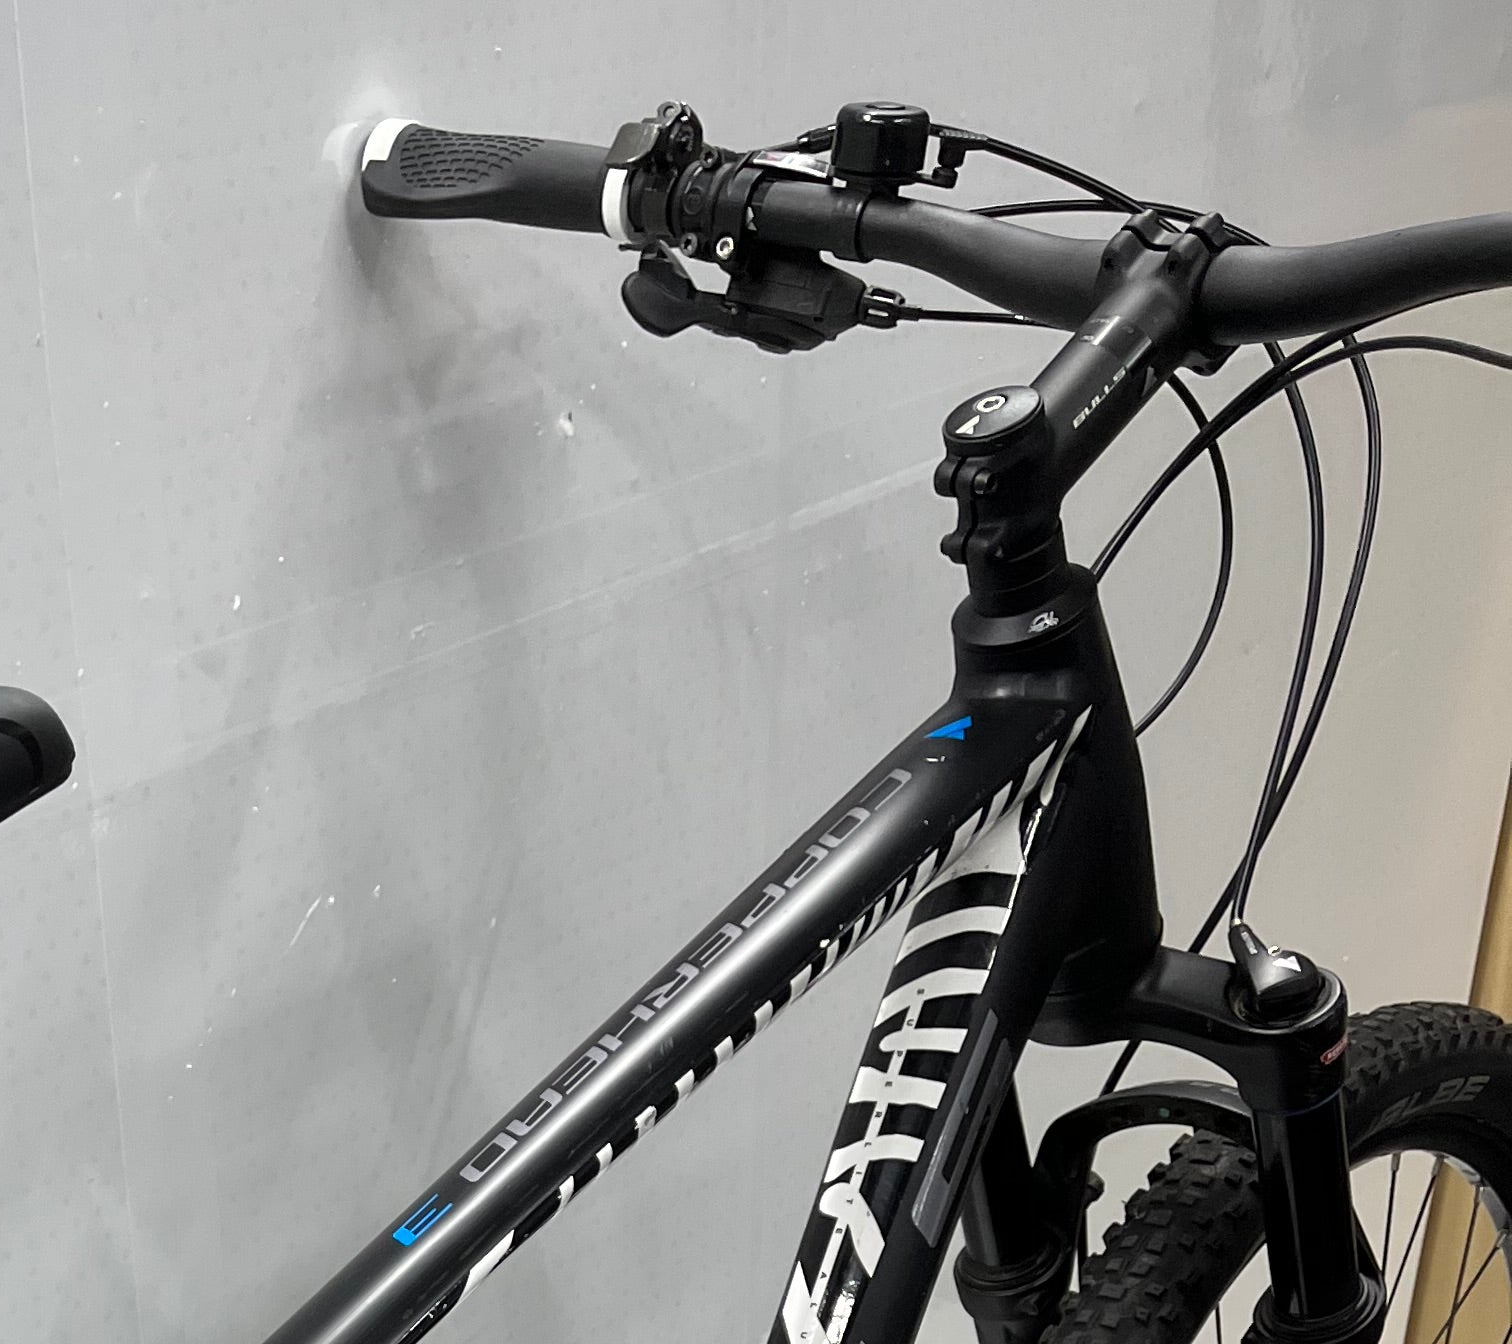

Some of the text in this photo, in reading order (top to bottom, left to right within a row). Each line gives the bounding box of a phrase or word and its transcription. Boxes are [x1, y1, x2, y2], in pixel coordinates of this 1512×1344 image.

[1072, 365, 1126, 429] BULLS
[459, 768, 912, 1183] COPPERHEAD
[834, 986, 926, 1236] SUPERLITE
